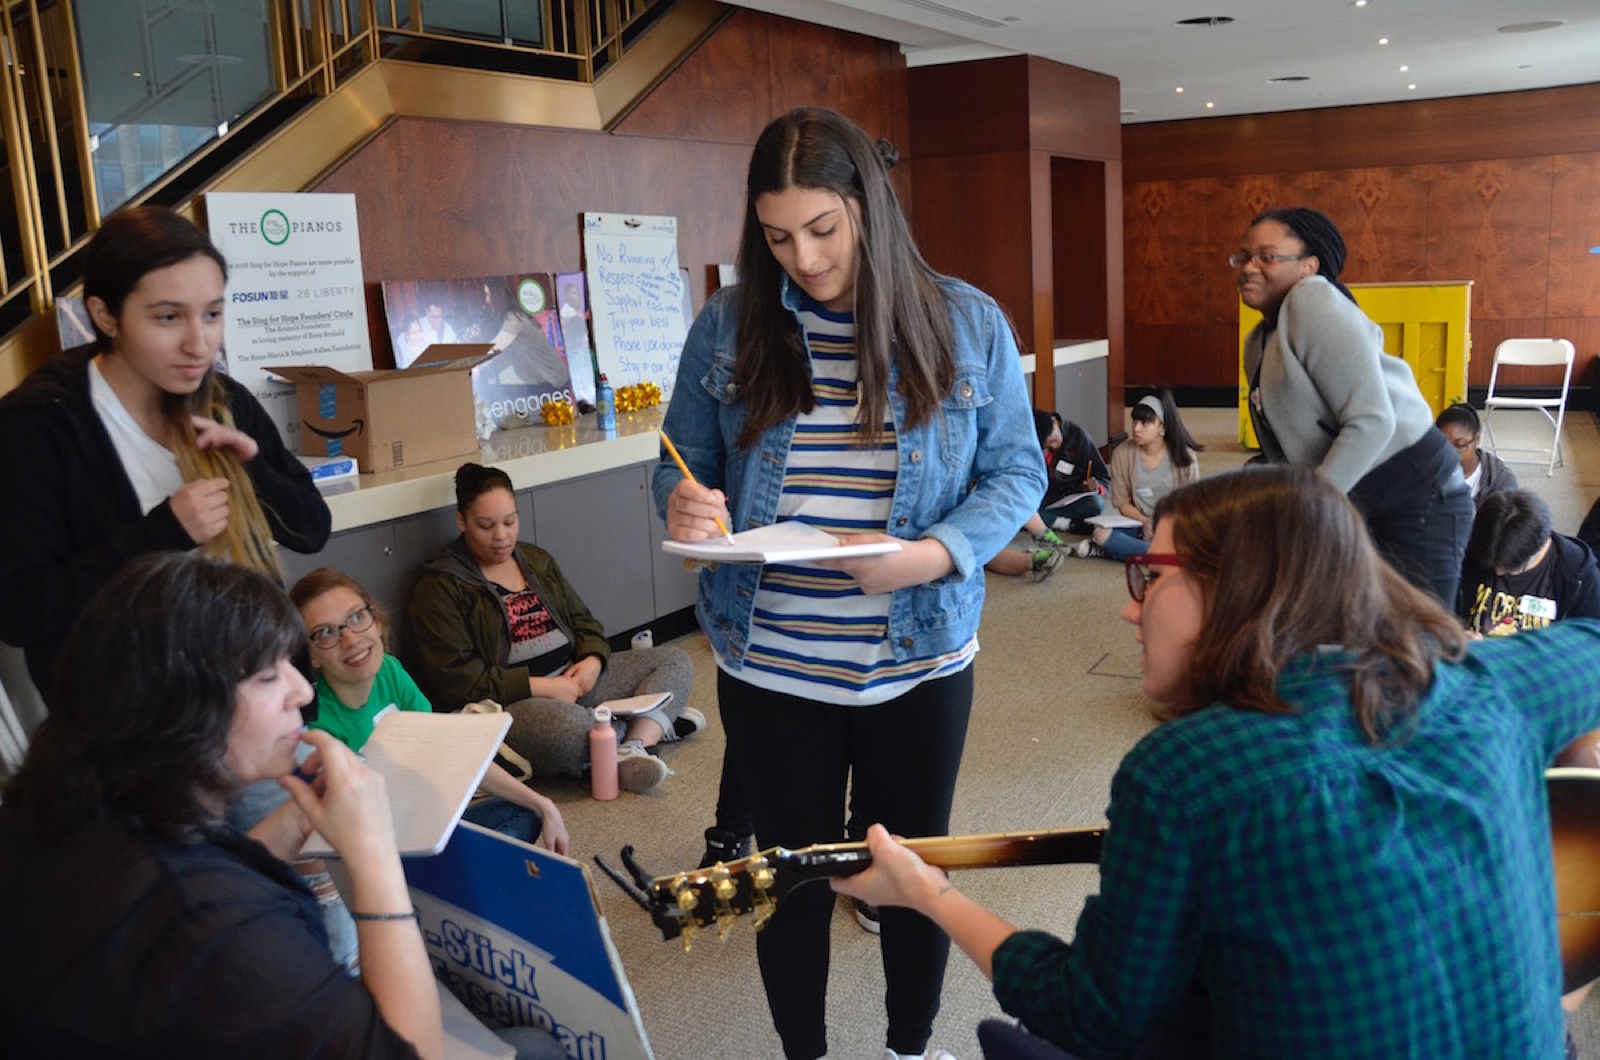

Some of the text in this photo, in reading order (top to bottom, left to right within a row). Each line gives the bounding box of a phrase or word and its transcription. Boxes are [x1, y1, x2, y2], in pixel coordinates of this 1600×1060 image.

[228, 221, 342, 234] THE PIANOS
[273, 260, 288, 269] Hope
[596, 243, 613, 264] No
[620, 242, 656, 272] Running
[599, 266, 634, 292] Respect
[232, 291, 268, 303] FOSUN
[297, 286, 355, 298] 28 LIBERTY
[604, 289, 641, 313] Support
[236, 316, 251, 326] The
[252, 315, 268, 326] Sing
[269, 314, 279, 323] for
[280, 313, 299, 324] Hope
[333, 308, 353, 318] Circle
[608, 311, 669, 335] Try your best
[264, 326, 276, 334] The
[300, 322, 331, 330] Foundation
[613, 335, 641, 352] Phone
[237, 354, 249, 363] The
[423, 918, 540, 1001] -Stick
